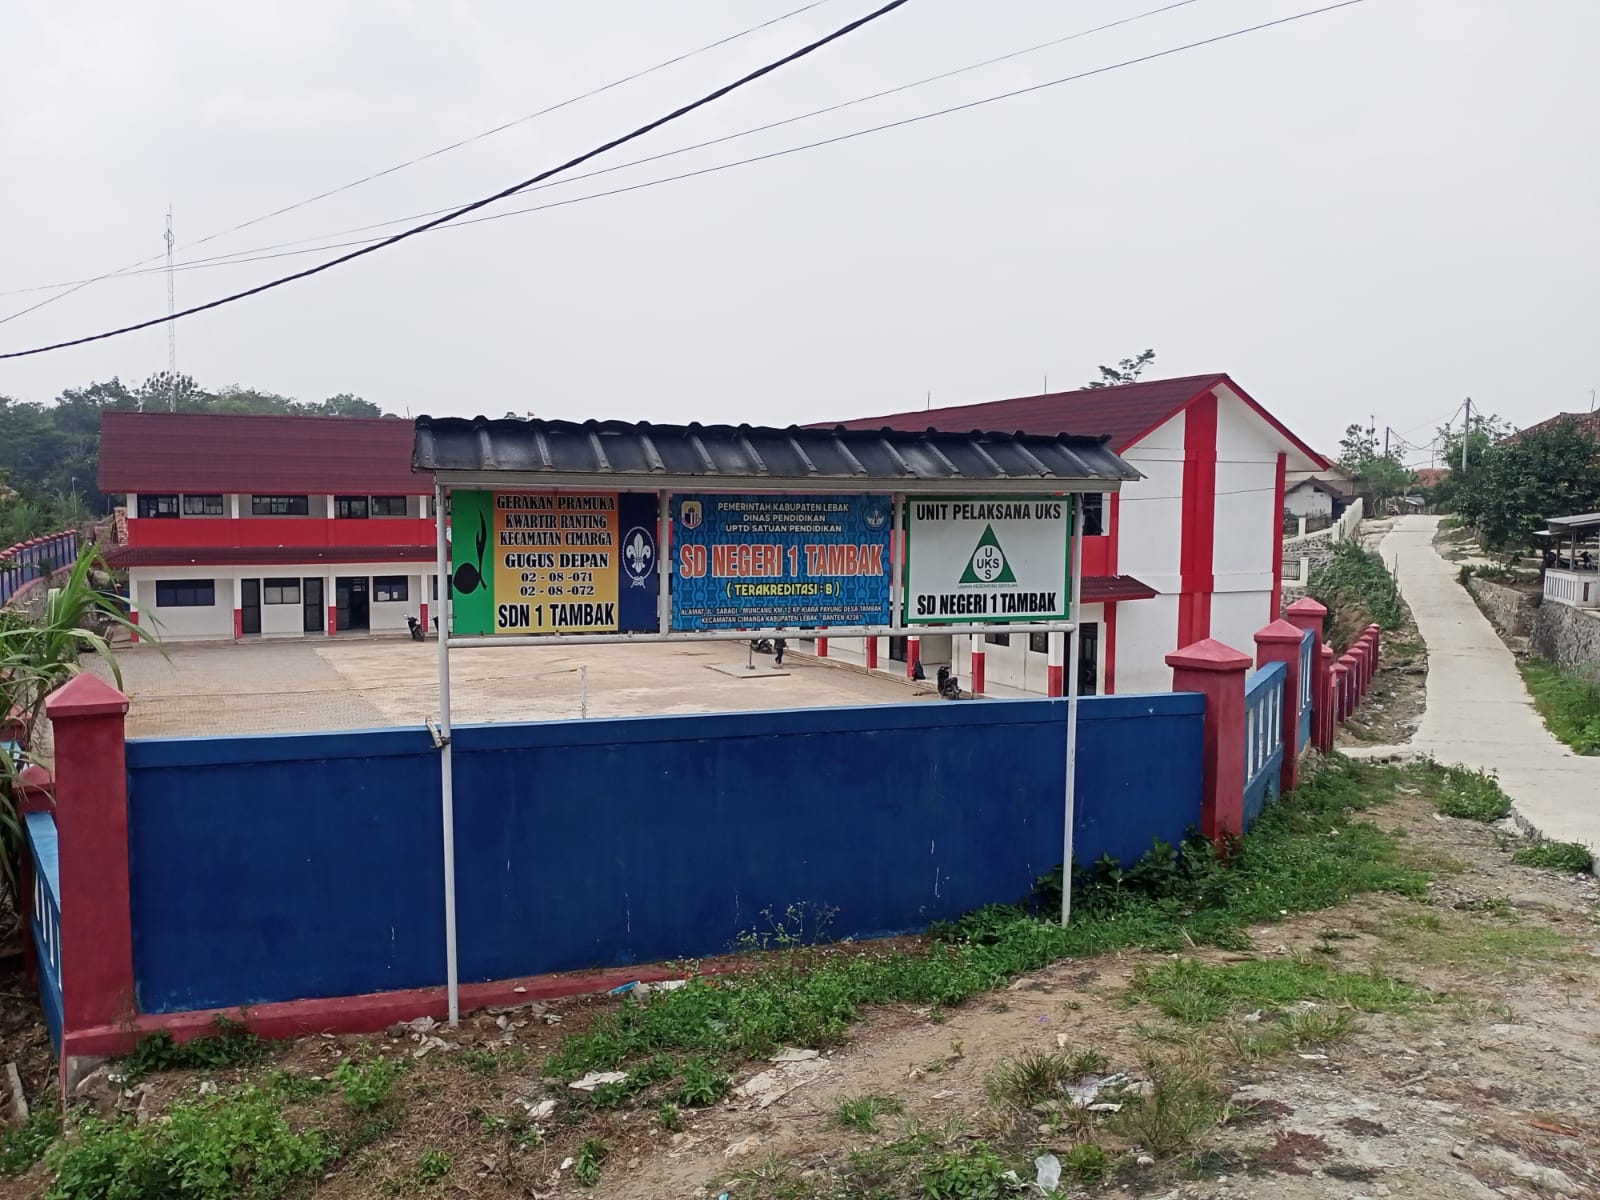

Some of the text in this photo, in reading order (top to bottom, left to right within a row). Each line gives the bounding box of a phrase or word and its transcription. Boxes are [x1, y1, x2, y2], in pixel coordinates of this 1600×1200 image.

[497, 496, 615, 510] GERAKAN PRAMUKA
[718, 502, 849, 512] PEMERINTAH KABUPATEN LEBAK
[743, 514, 825, 522] DINAS PENDIDIKAN
[917, 503, 1061, 520] UNIT PELAKSANA UKS
[505, 515, 606, 528] KWARTIR RANTING
[500, 532, 612, 546] KECAMATAN CIMARGA
[505, 554, 608, 568] GUGUS DEPAN
[680, 544, 884, 579] SD NEGERI 1 TAMBAK
[977, 559, 999, 569] UKS
[521, 572, 536, 582] 02
[549, 572, 564, 582] 08
[520, 586, 536, 596] 02
[548, 586, 563, 596] 08
[917, 592, 1056, 615] SD NEGERI 1 TAMBAK
[498, 603, 615, 628] SDN 1 TAMBAK
